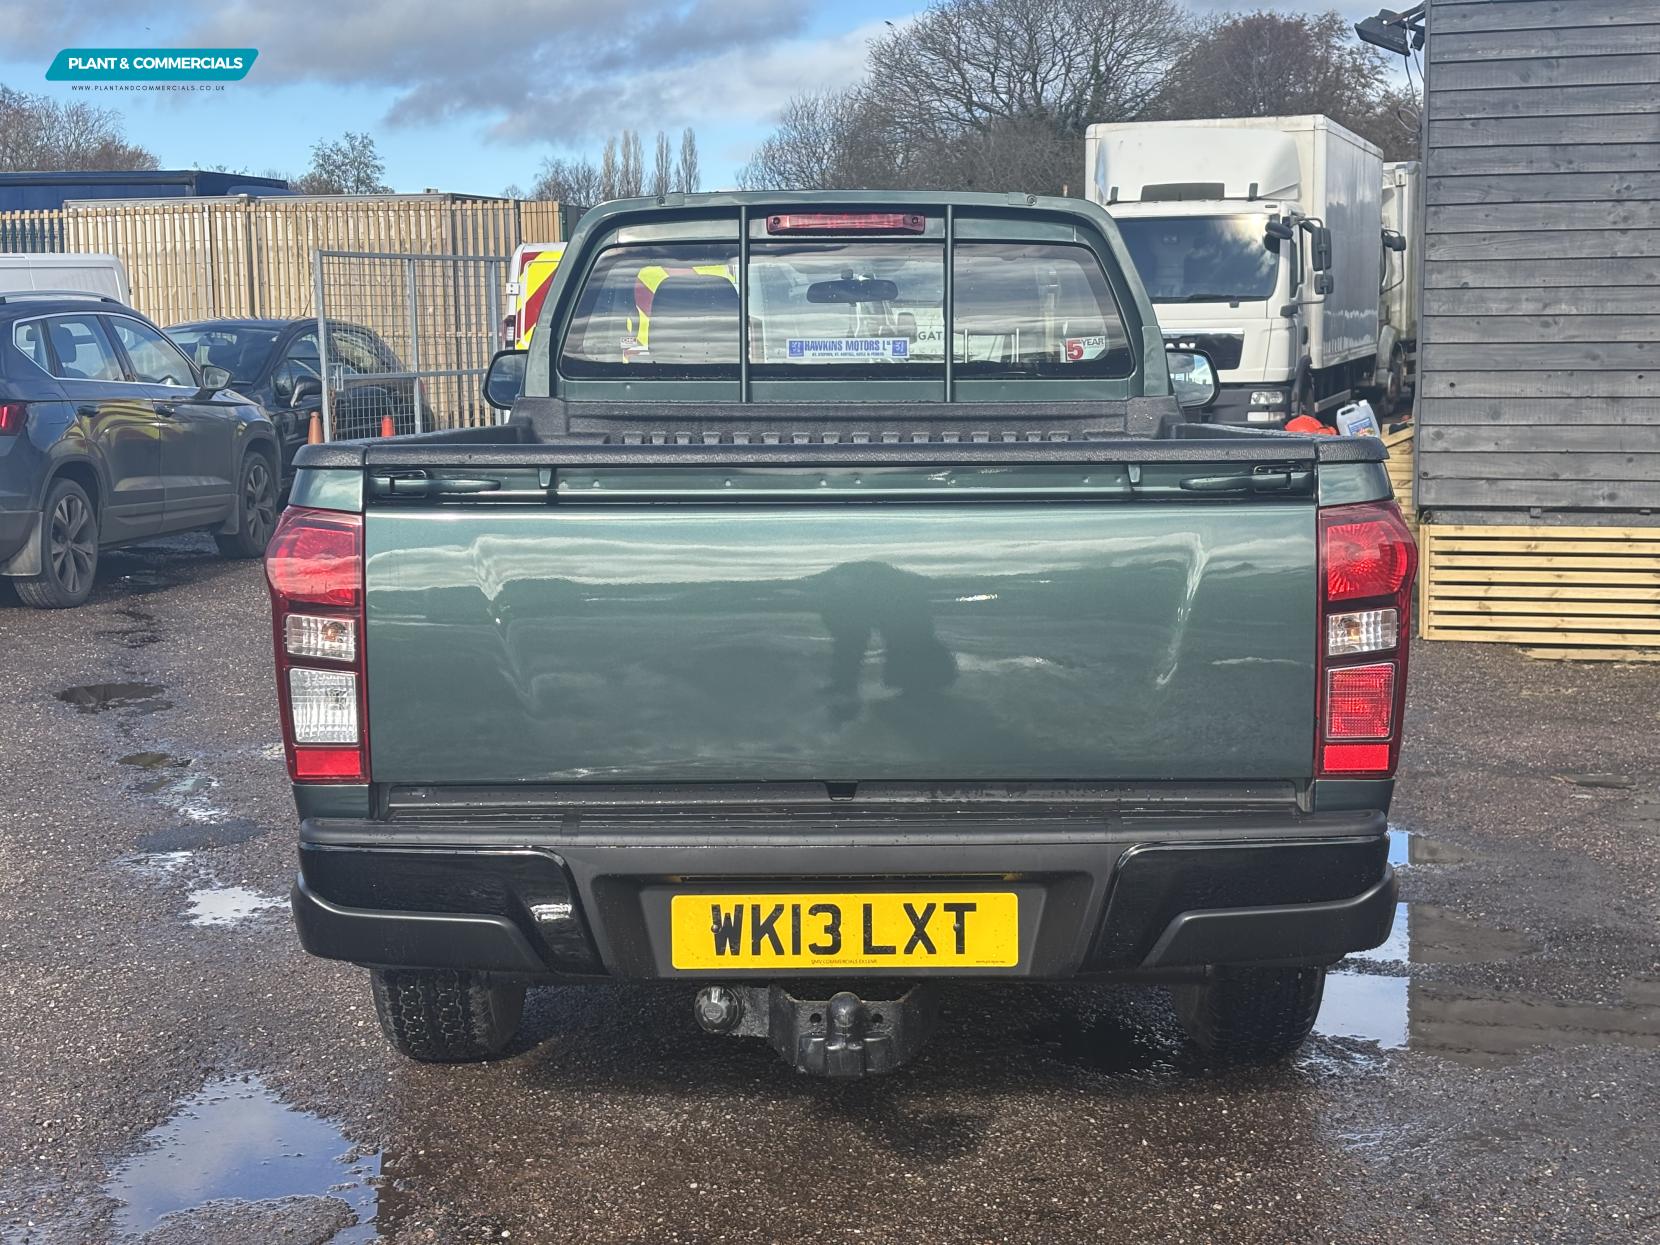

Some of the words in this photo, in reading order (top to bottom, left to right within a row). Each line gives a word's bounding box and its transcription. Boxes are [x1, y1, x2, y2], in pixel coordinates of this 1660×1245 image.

[918, 331, 945, 340] GAT
[804, 340, 843, 351] HAWKINS
[846, 340, 880, 351] MOTORS
[1067, 339, 1084, 360] 5
[1081, 338, 1104, 346] YEAR
[711, 903, 842, 956] WK13
[863, 903, 977, 956] LXT
